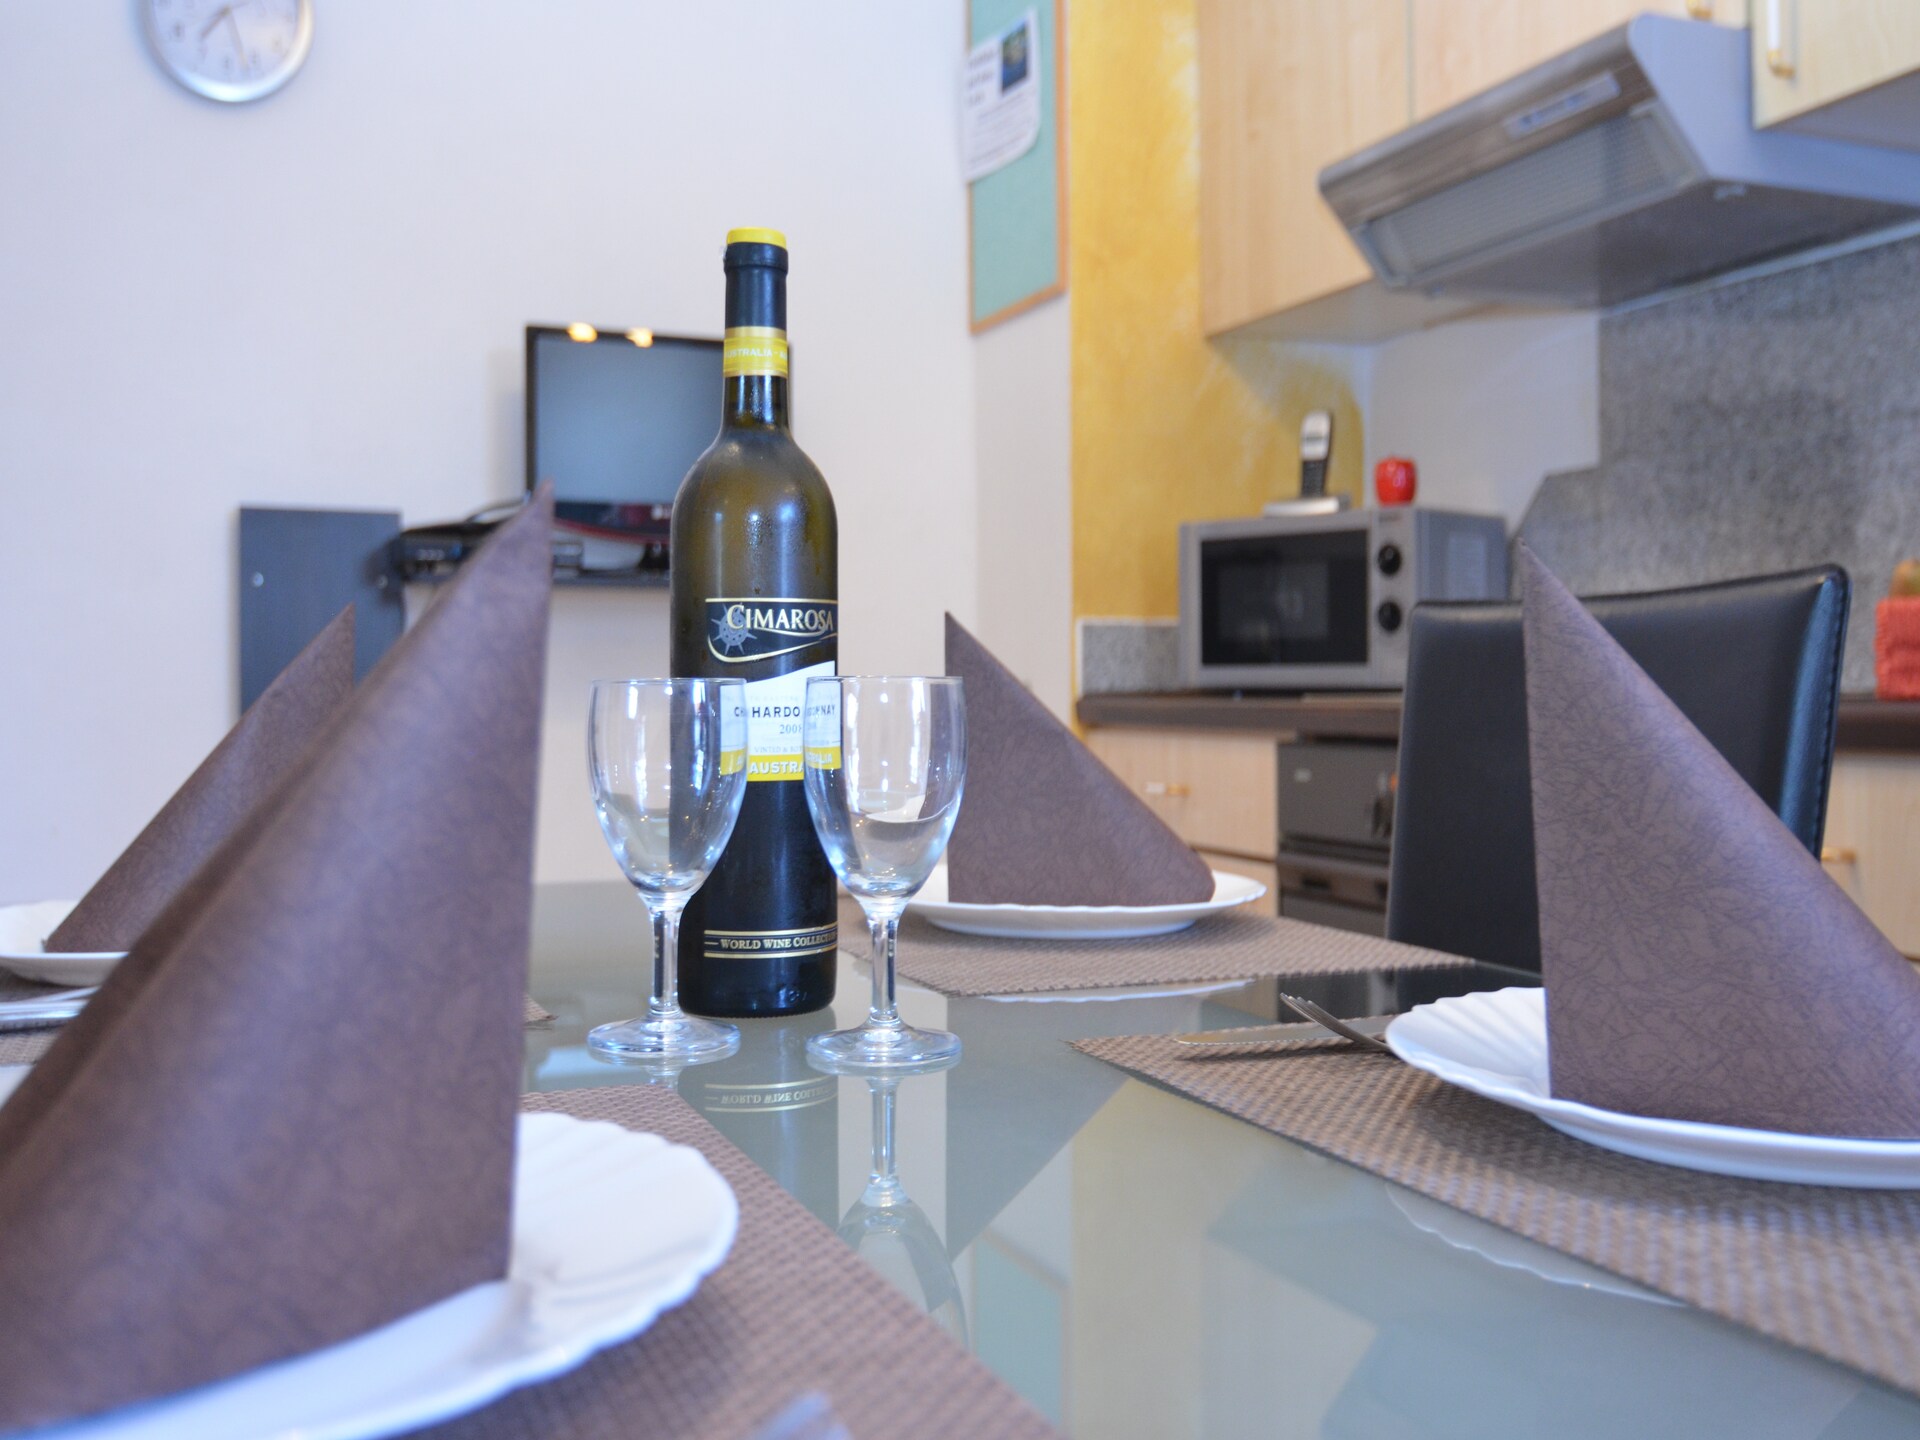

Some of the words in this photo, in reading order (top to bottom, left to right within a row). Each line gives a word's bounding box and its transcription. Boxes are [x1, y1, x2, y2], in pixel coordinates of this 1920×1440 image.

[727, 604, 833, 631] CIMAROSA
[720, 938, 761, 950] WORLD
[763, 938, 791, 949] WINE
[793, 931, 836, 947] COLLECT
